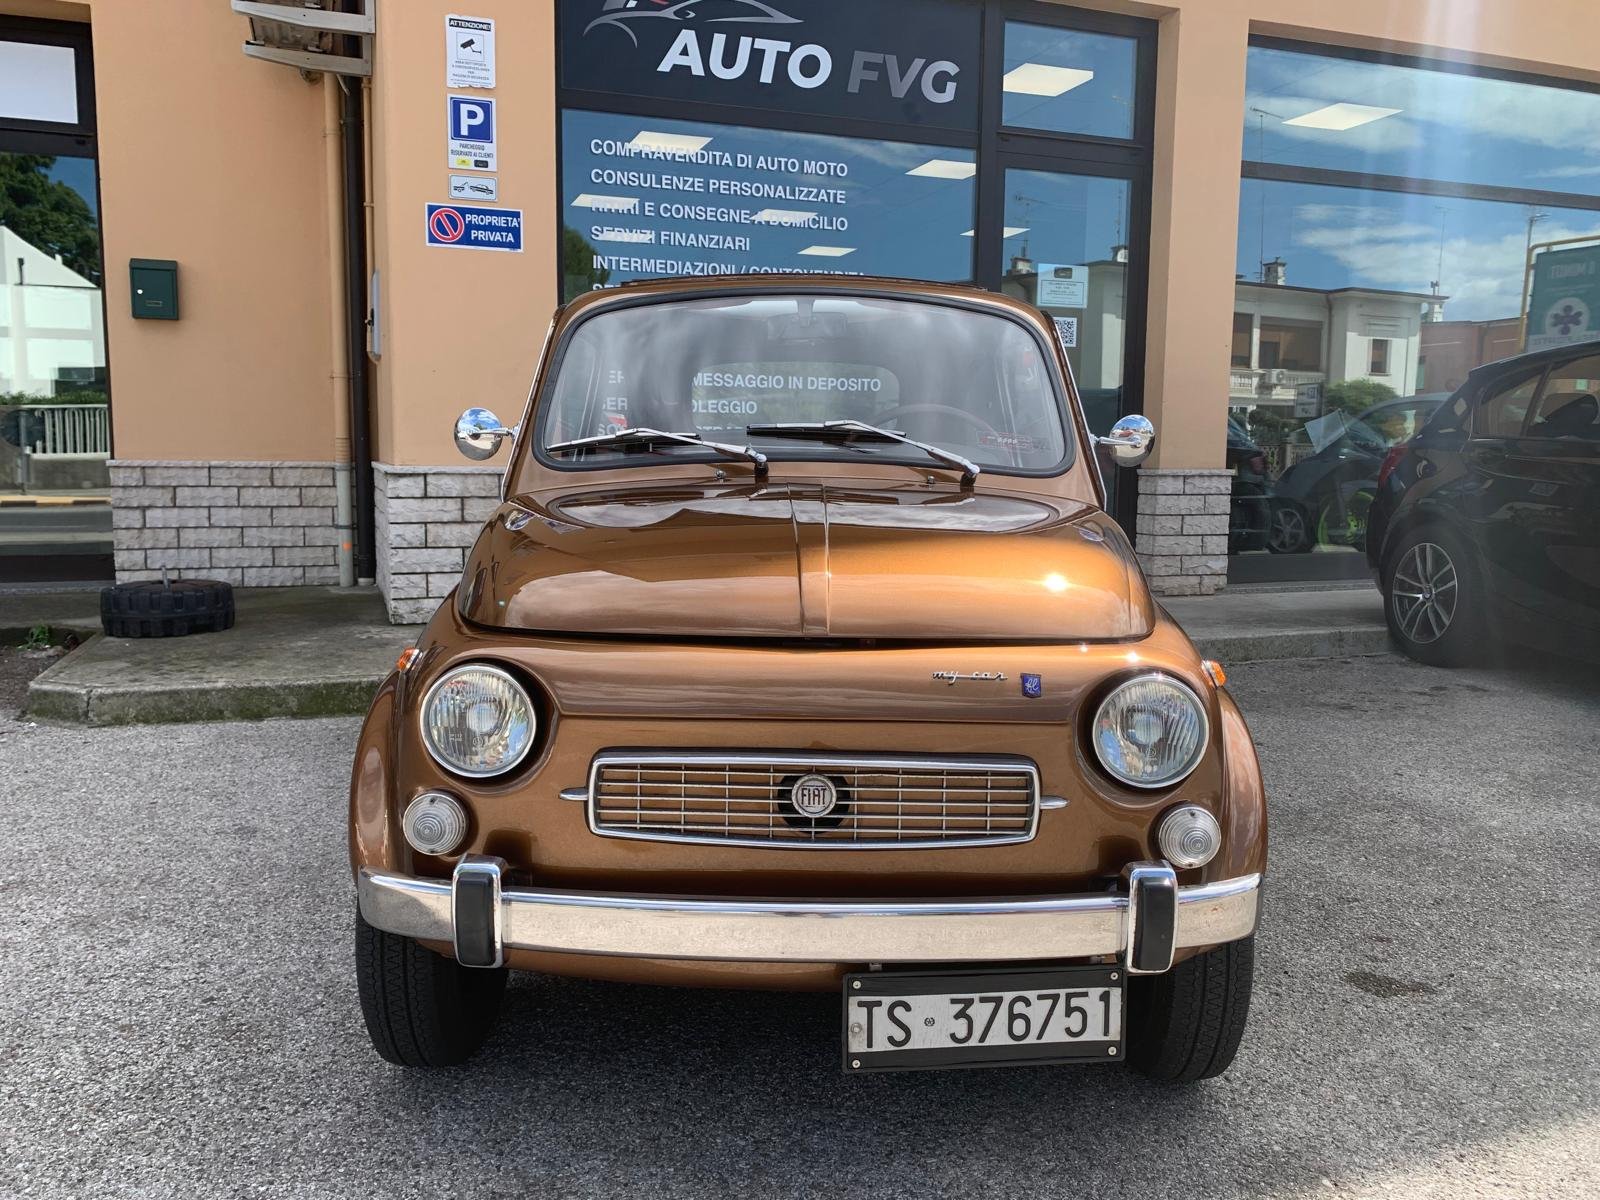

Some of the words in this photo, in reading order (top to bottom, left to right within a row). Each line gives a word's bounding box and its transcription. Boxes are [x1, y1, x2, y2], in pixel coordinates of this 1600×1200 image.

[656, 29, 833, 89] AUTO
[847, 50, 960, 104] FVG
[459, 103, 485, 136] P
[590, 139, 733, 166] COMPRAVENDITA
[736, 153, 752, 168] DI
[756, 155, 799, 173] AUTO
[803, 160, 848, 177] MOTO
[590, 168, 705, 192] CONSULENZE
[708, 179, 846, 204] PERSONALIZZATE
[465, 213, 520, 228] PROPRIETA'
[644, 202, 655, 216] E
[659, 203, 751, 224] CONSEGNE
[470, 230, 515, 243] PRIVATA
[660, 231, 750, 251] FINANZIARI
[592, 255, 736, 276] INTERMEDIAZIONI
[788, 376, 803, 390] IN
[807, 376, 882, 392] DEPOSITO
[932, 671, 959, 686] my
[970, 671, 1008, 681] car
[801, 787, 827, 806] FIAT
[857, 1000, 912, 1048] TS
[949, 990, 1111, 1045] 376751
